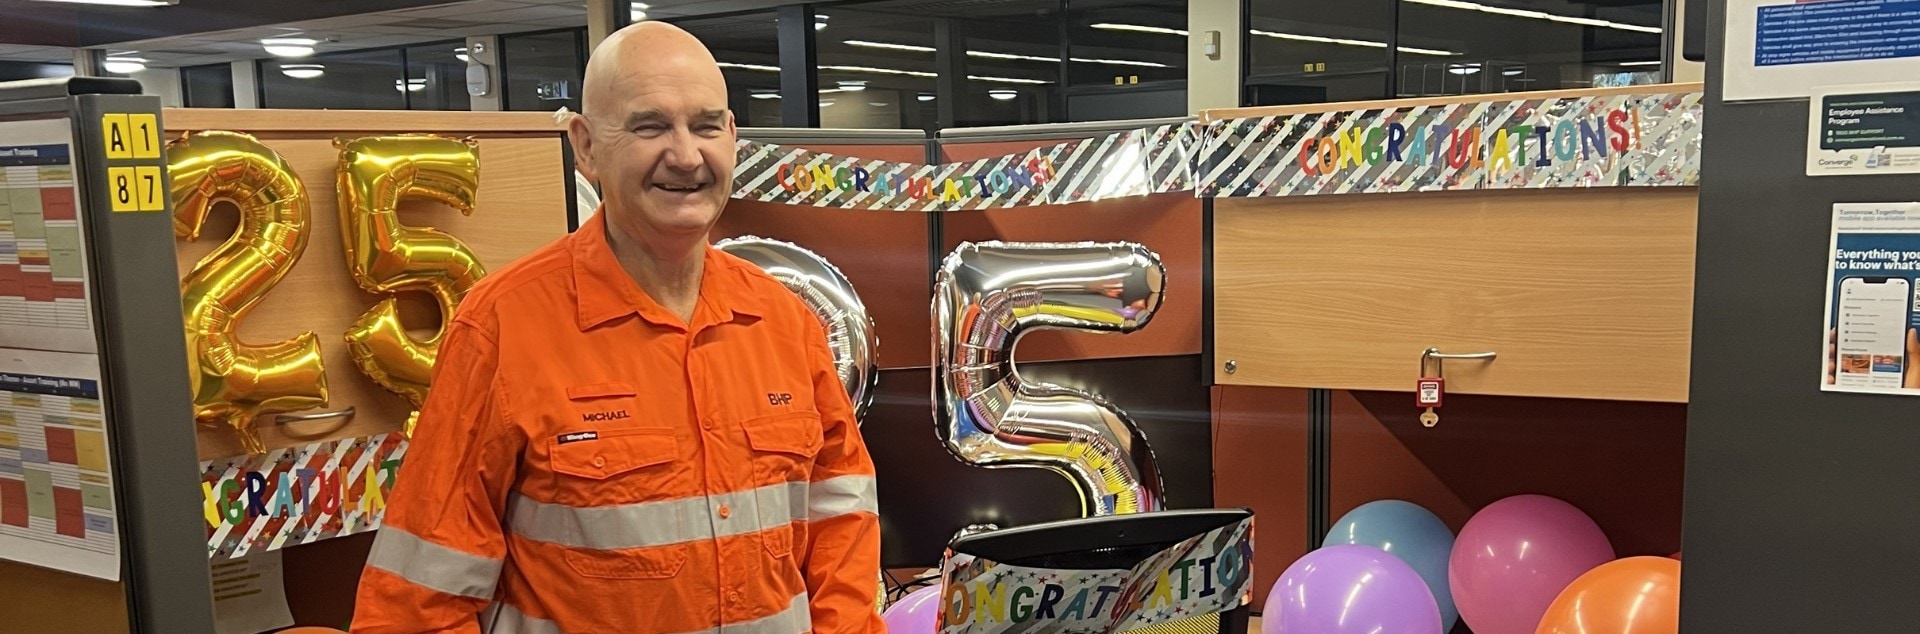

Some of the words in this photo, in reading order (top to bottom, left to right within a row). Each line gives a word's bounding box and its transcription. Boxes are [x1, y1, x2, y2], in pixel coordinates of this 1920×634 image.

[1828, 108, 1864, 116] Employee
[1828, 118, 1860, 126] Program
[1299, 107, 1643, 177] CONGRATULATIONS!
[1819, 158, 1853, 166] Converge
[777, 155, 1057, 202] CONGRATULATIONS!
[1836, 248, 1900, 261] Everything
[1836, 260, 1847, 269] to
[1849, 260, 1882, 269] know
[767, 393, 793, 406] BHP
[582, 409, 631, 422] MICHAEL
